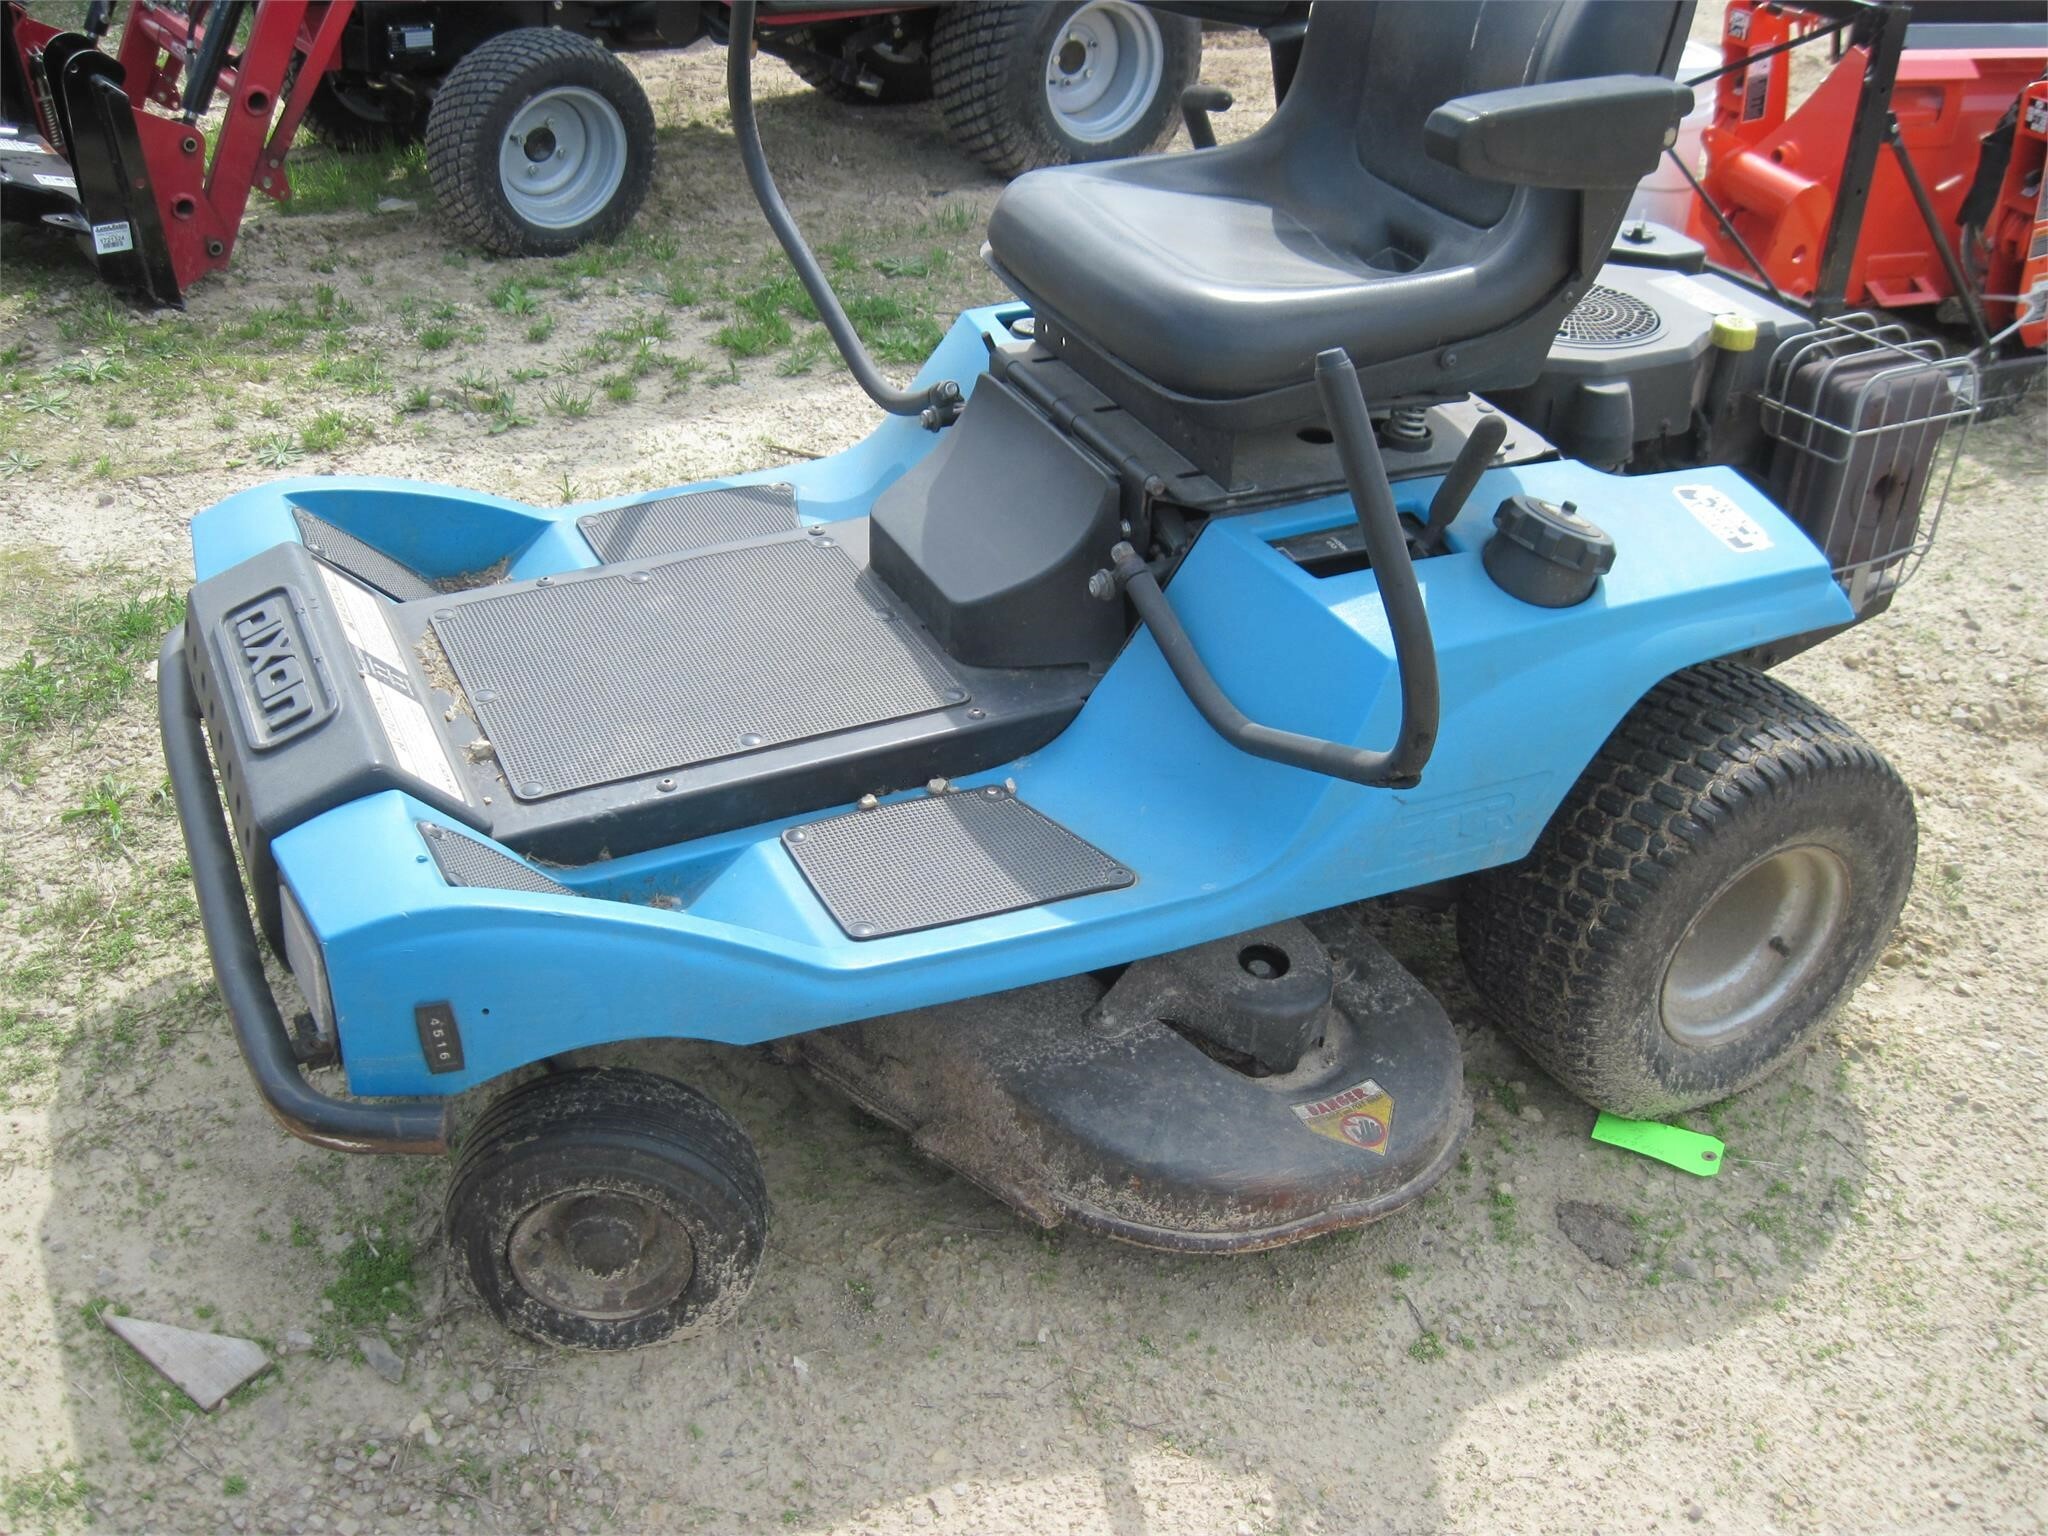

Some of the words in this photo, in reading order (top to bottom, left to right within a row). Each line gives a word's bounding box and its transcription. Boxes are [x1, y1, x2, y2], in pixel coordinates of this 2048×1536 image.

[235, 599, 313, 733] DIXON
[430, 1017, 450, 1060] 4516
[1305, 1087, 1368, 1116] DANGER
